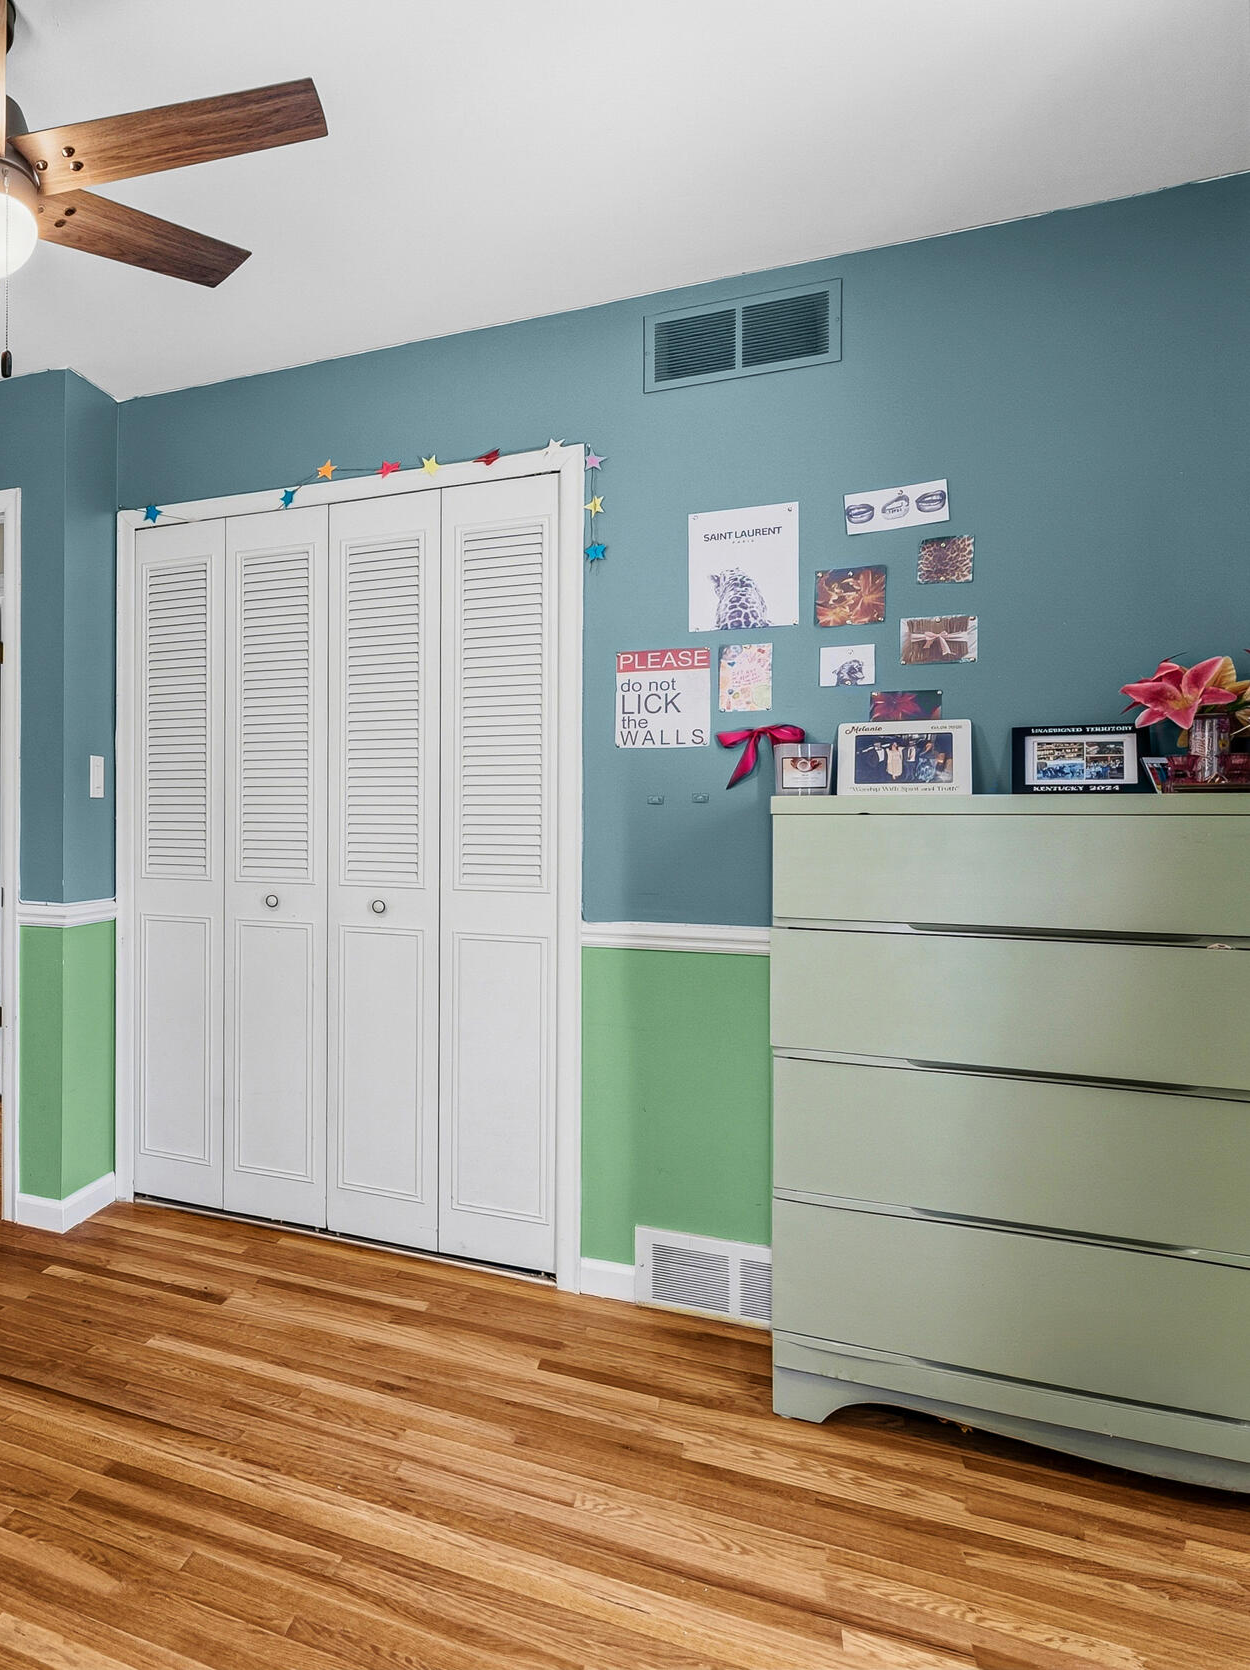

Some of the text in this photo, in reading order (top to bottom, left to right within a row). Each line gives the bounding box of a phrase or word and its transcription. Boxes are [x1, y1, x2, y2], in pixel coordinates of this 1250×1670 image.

[703, 526, 782, 542] SAINT LAURENT
[619, 650, 708, 670] PLEASE
[620, 678, 676, 692] do not
[622, 692, 681, 714] LICK
[622, 716, 648, 729] the
[845, 726, 882, 735] Melanie
[620, 729, 705, 746] WALLS
